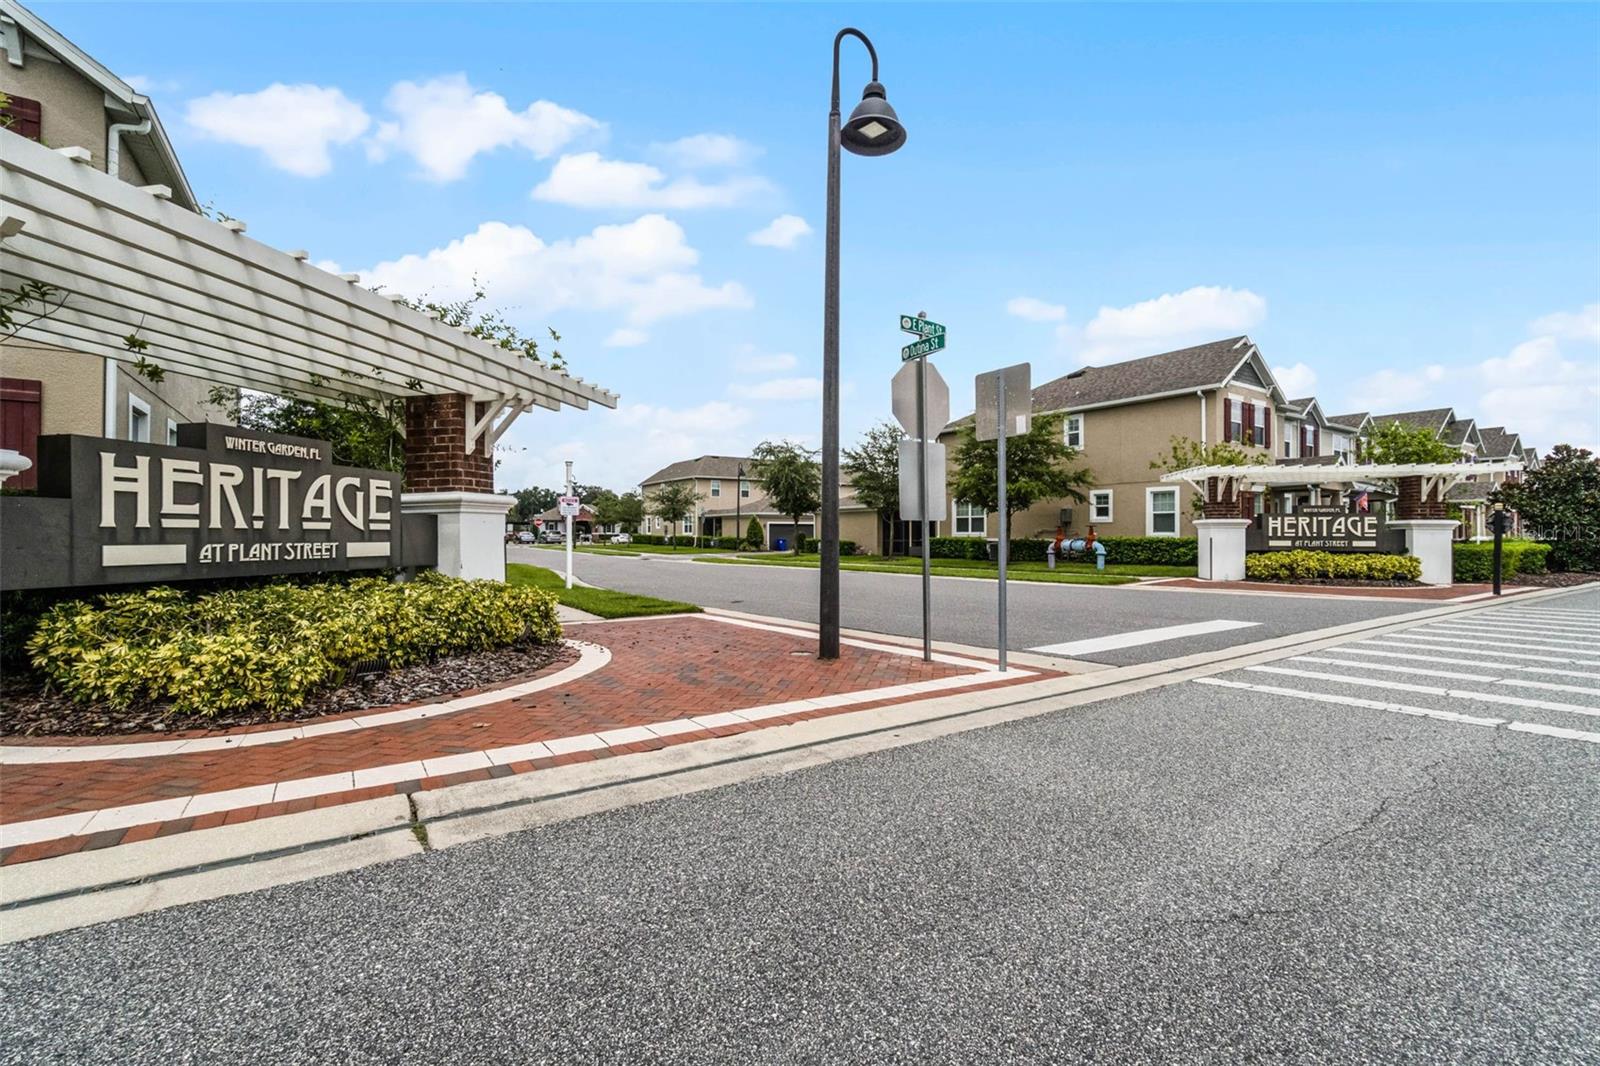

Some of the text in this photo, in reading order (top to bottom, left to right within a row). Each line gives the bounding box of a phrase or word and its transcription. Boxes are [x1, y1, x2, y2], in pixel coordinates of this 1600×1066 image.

[912, 319, 918, 331] E
[918, 320, 935, 337] Plant
[930, 337, 939, 350] St
[224, 435, 322, 461] WINTER GARDEN, FL
[98, 451, 393, 531] HERITAGE
[1268, 516, 1378, 537] HERITAGE
[199, 542, 339, 564] AT PLANT STREET
